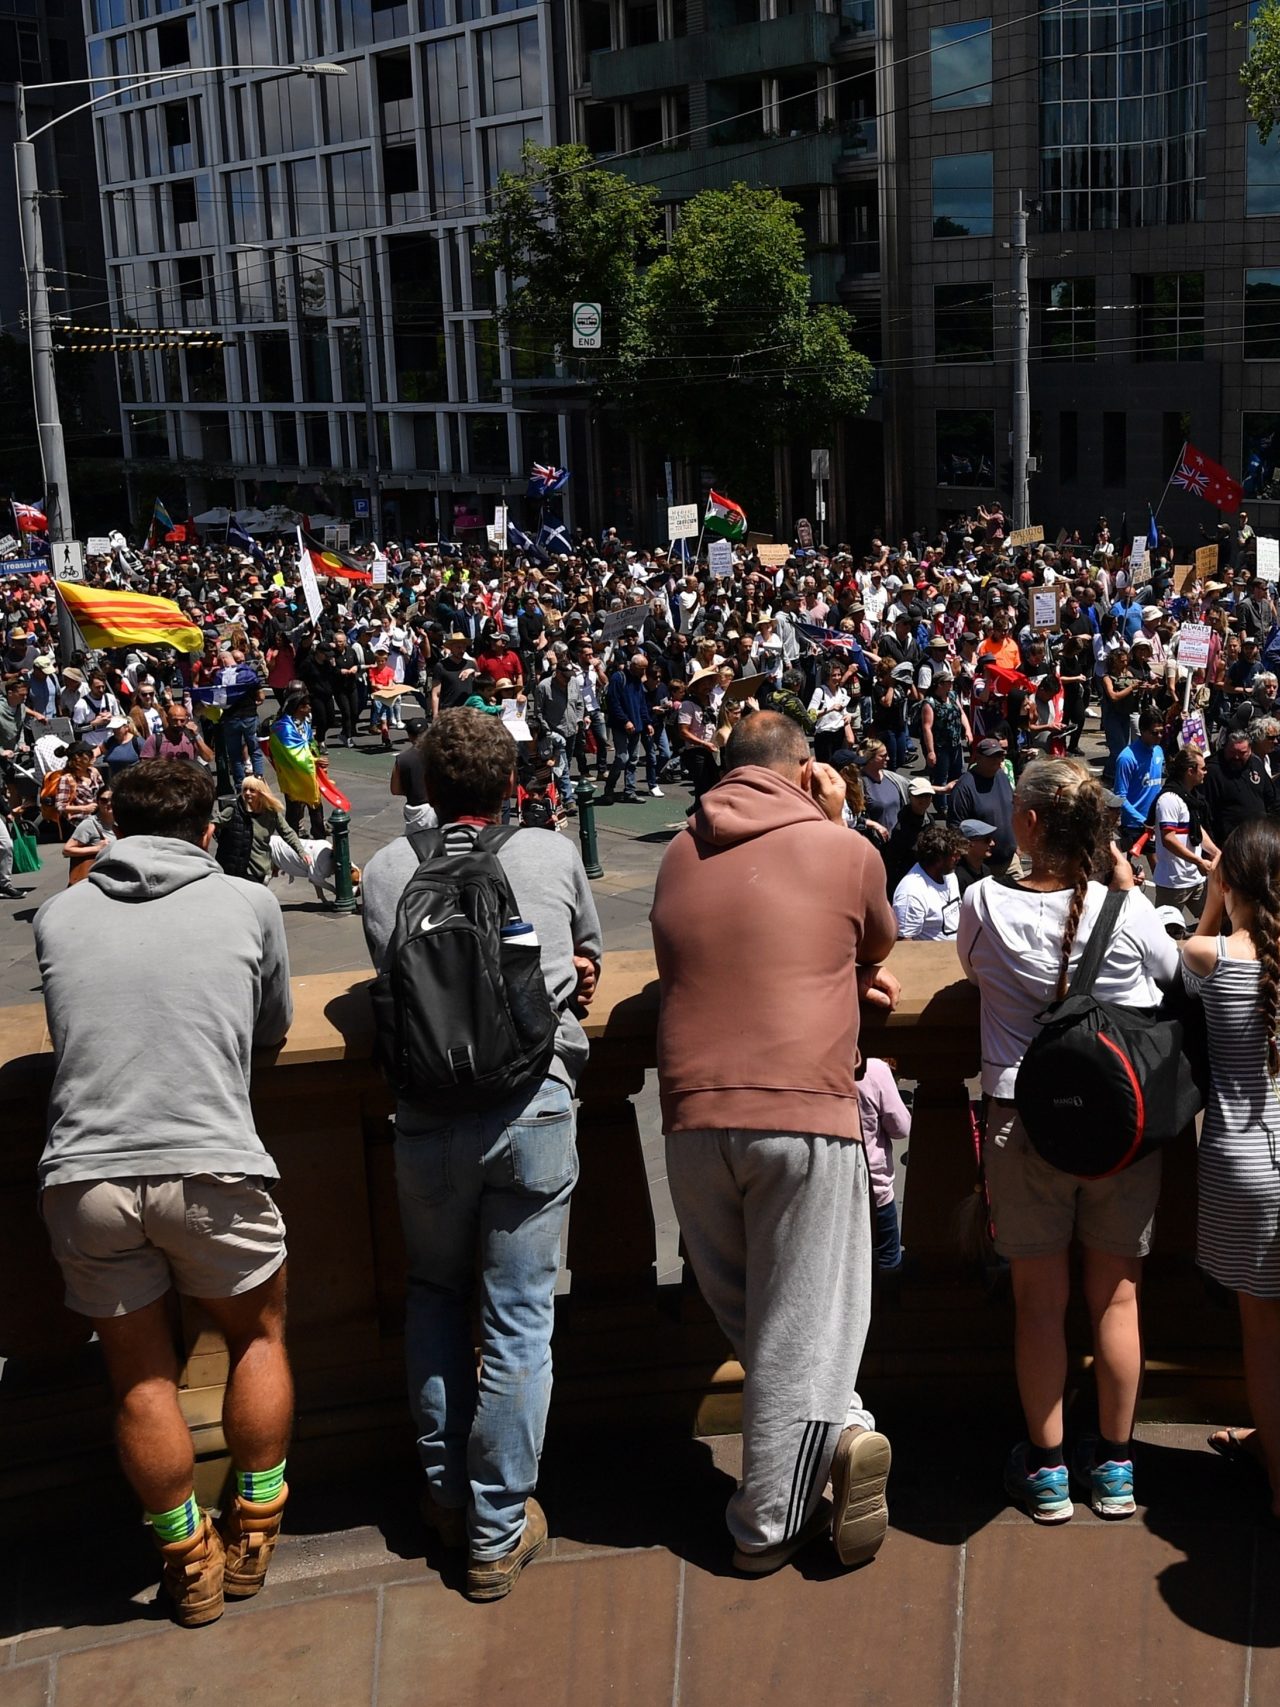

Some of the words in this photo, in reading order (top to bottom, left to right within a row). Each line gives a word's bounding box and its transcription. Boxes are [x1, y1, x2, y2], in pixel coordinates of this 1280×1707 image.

[579, 338, 595, 346] END
[357, 501, 365, 511] P
[1, 561, 38, 570] Treasury
[38, 559, 47, 567] Pl
[1182, 624, 1209, 633] ALWAYS
